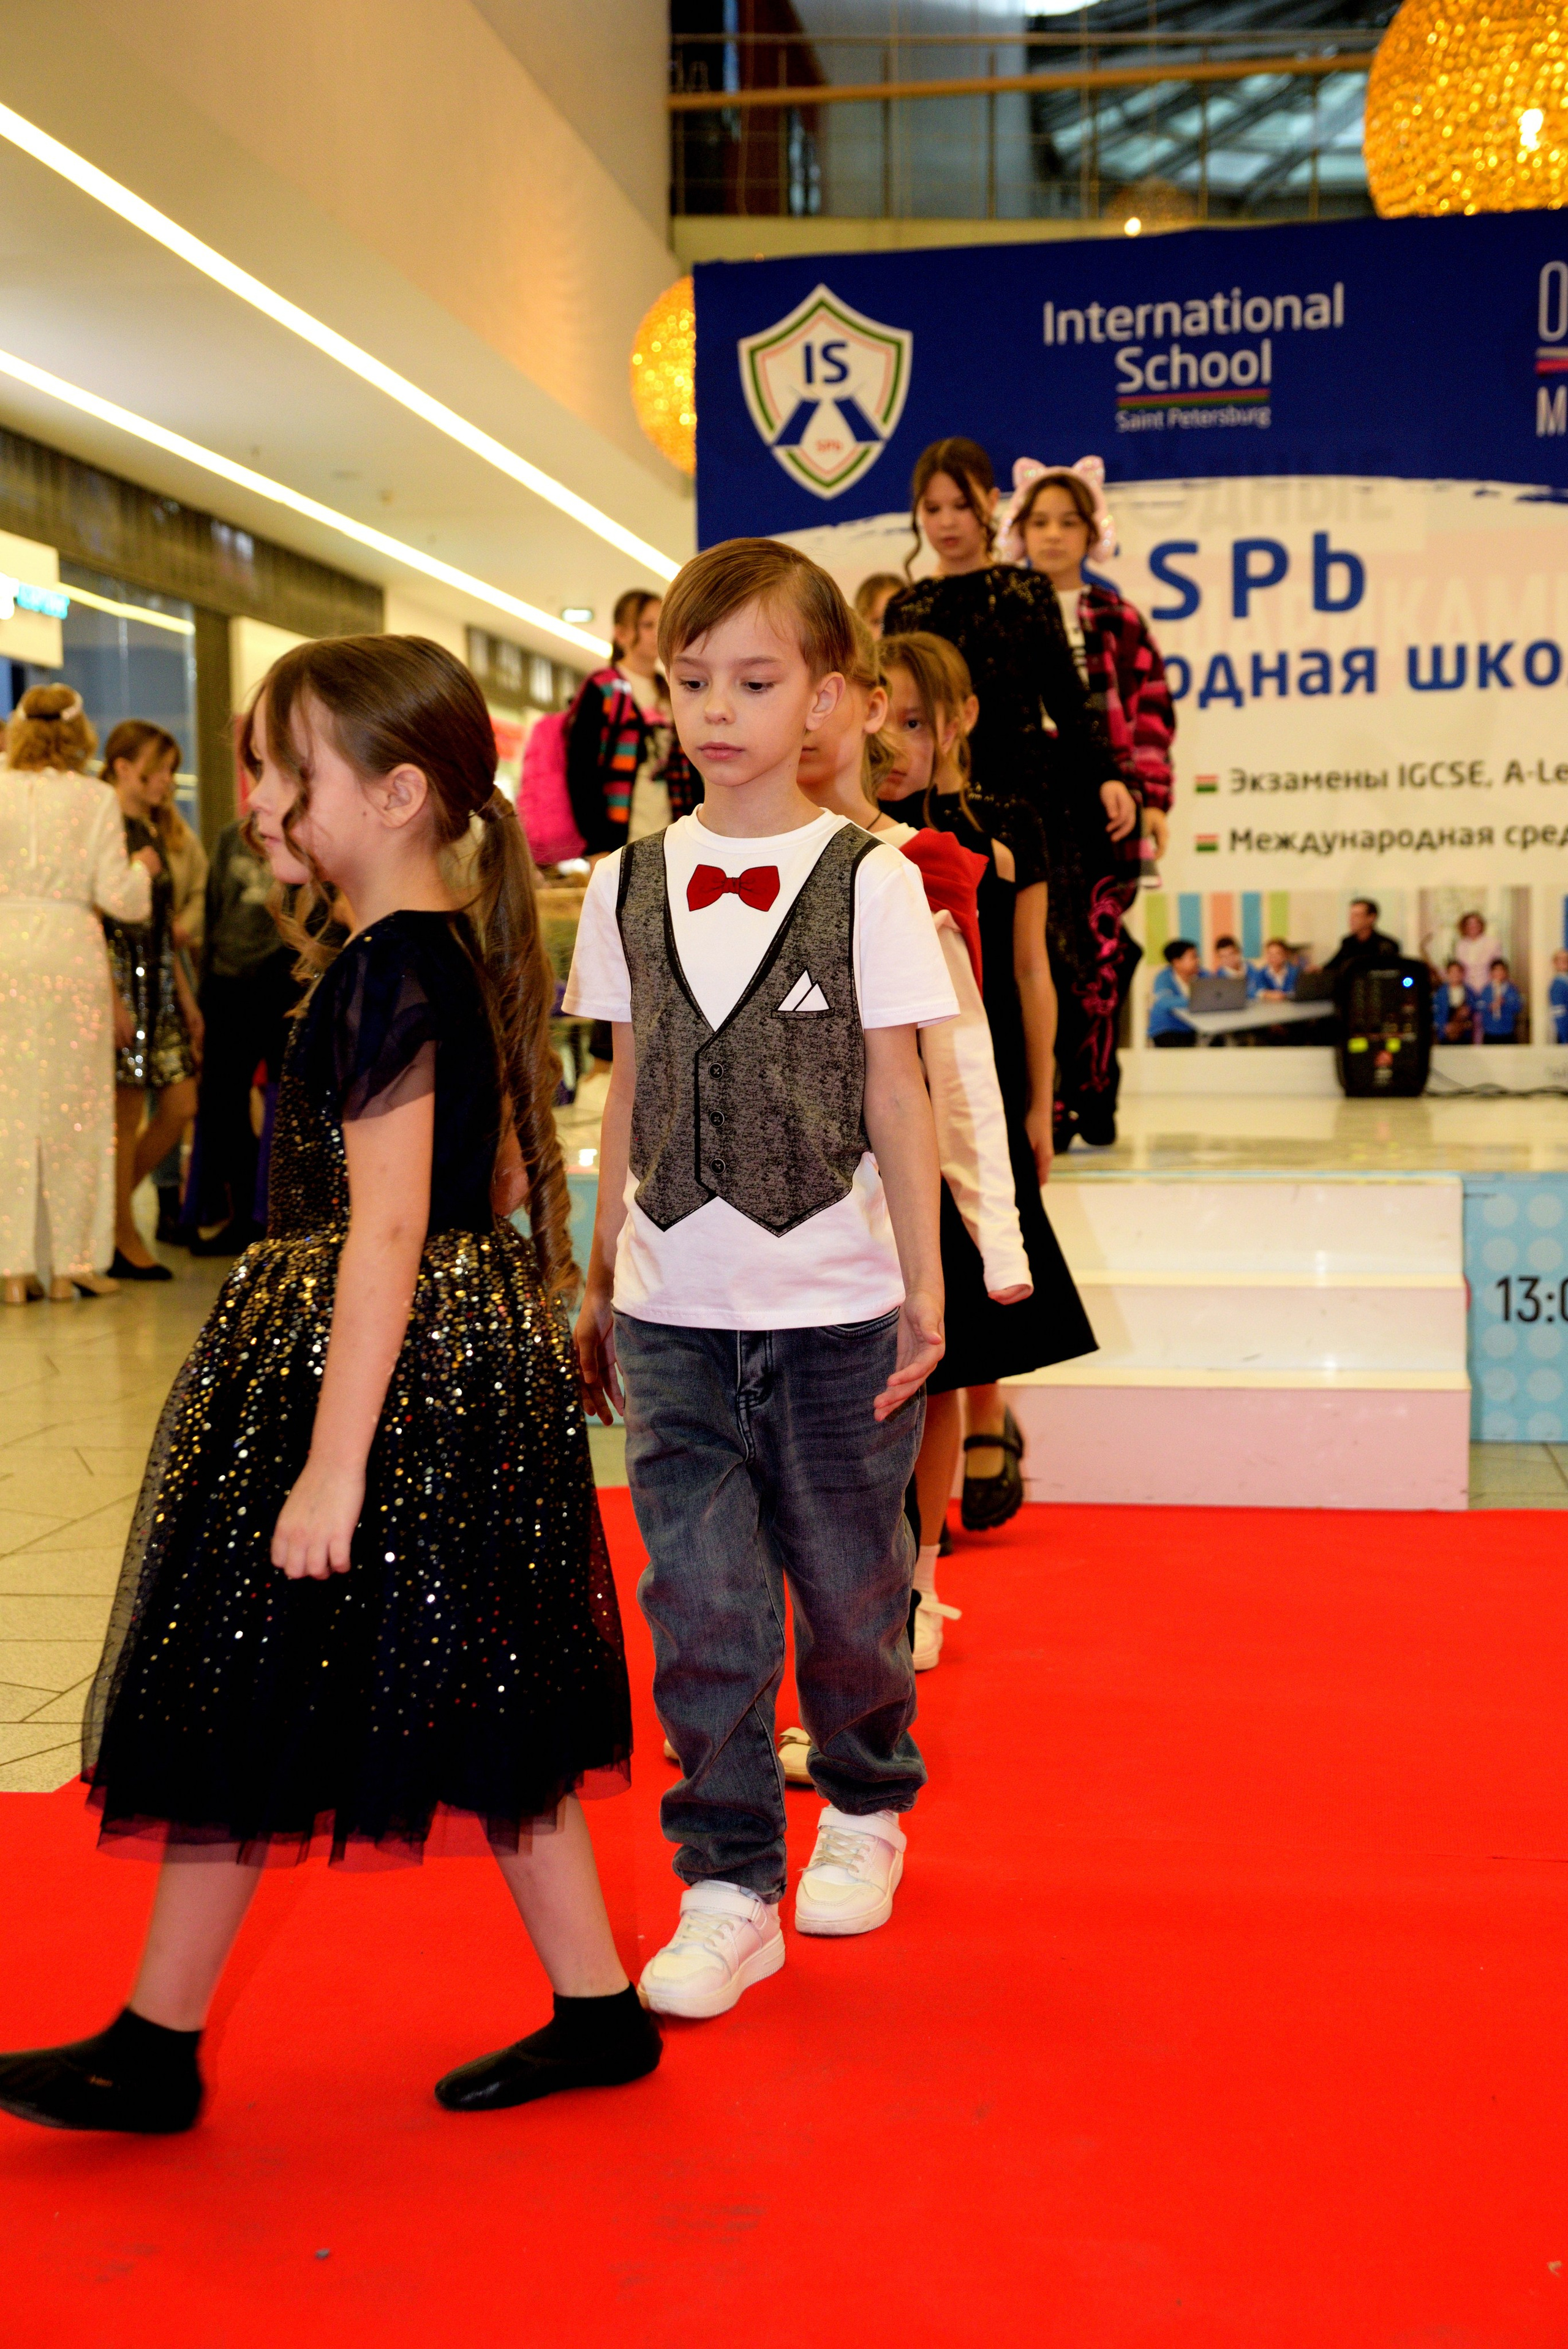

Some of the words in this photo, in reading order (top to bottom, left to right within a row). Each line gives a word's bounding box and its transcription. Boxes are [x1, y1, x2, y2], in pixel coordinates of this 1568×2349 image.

[1043, 282, 1344, 345] International
[803, 340, 850, 385] IS
[1115, 337, 1272, 393] School
[1115, 409, 1164, 432] Saint
[1167, 404, 1272, 429] Petersburg
[1229, 766, 1389, 794] Экзамены
[1398, 760, 1492, 789] IGCSE,
[1229, 824, 1494, 856] Международная
